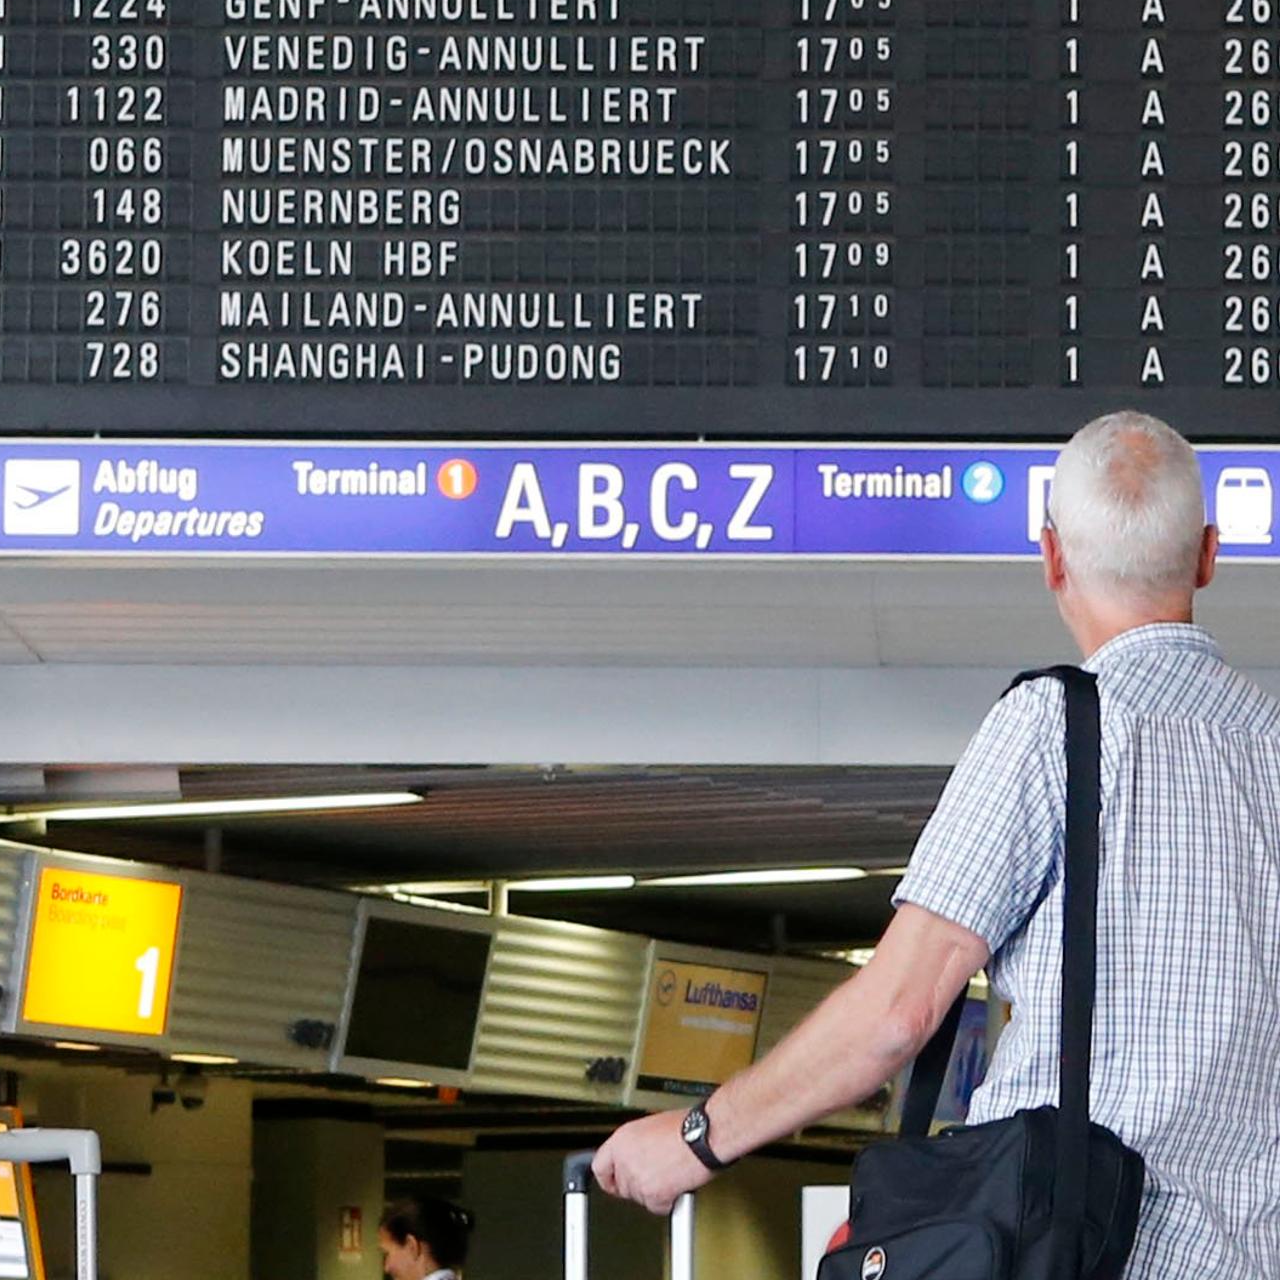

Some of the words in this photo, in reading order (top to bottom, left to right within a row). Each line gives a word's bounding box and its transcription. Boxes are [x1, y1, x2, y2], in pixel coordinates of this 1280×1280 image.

[225, 36, 704, 71] VENEDIG-ANNULLIERT
[225, 87, 676, 122] MADRID-ANNULLIERT
[223, 138, 729, 174] MUENSTER/OSNABRUECK
[223, 189, 459, 224] NUERNBERG
[223, 240, 351, 275] KOELN
[385, 241, 456, 275] HBF
[221, 292, 701, 328] MAILAND-ANNULLIERT
[221, 343, 619, 380] SHANGHAI-PUDONG
[93, 460, 198, 500] Abflug
[292, 461, 426, 495] Terminal
[449, 463, 462, 494] 1
[818, 465, 951, 499] Terminal
[973, 467, 992, 496] 2
[94, 502, 265, 542] Departures
[495, 462, 774, 548] A,B,C,Z
[51, 882, 109, 907] Bordkarte
[135, 946, 161, 1019] 1
[684, 978, 758, 1013] Lufthansa
